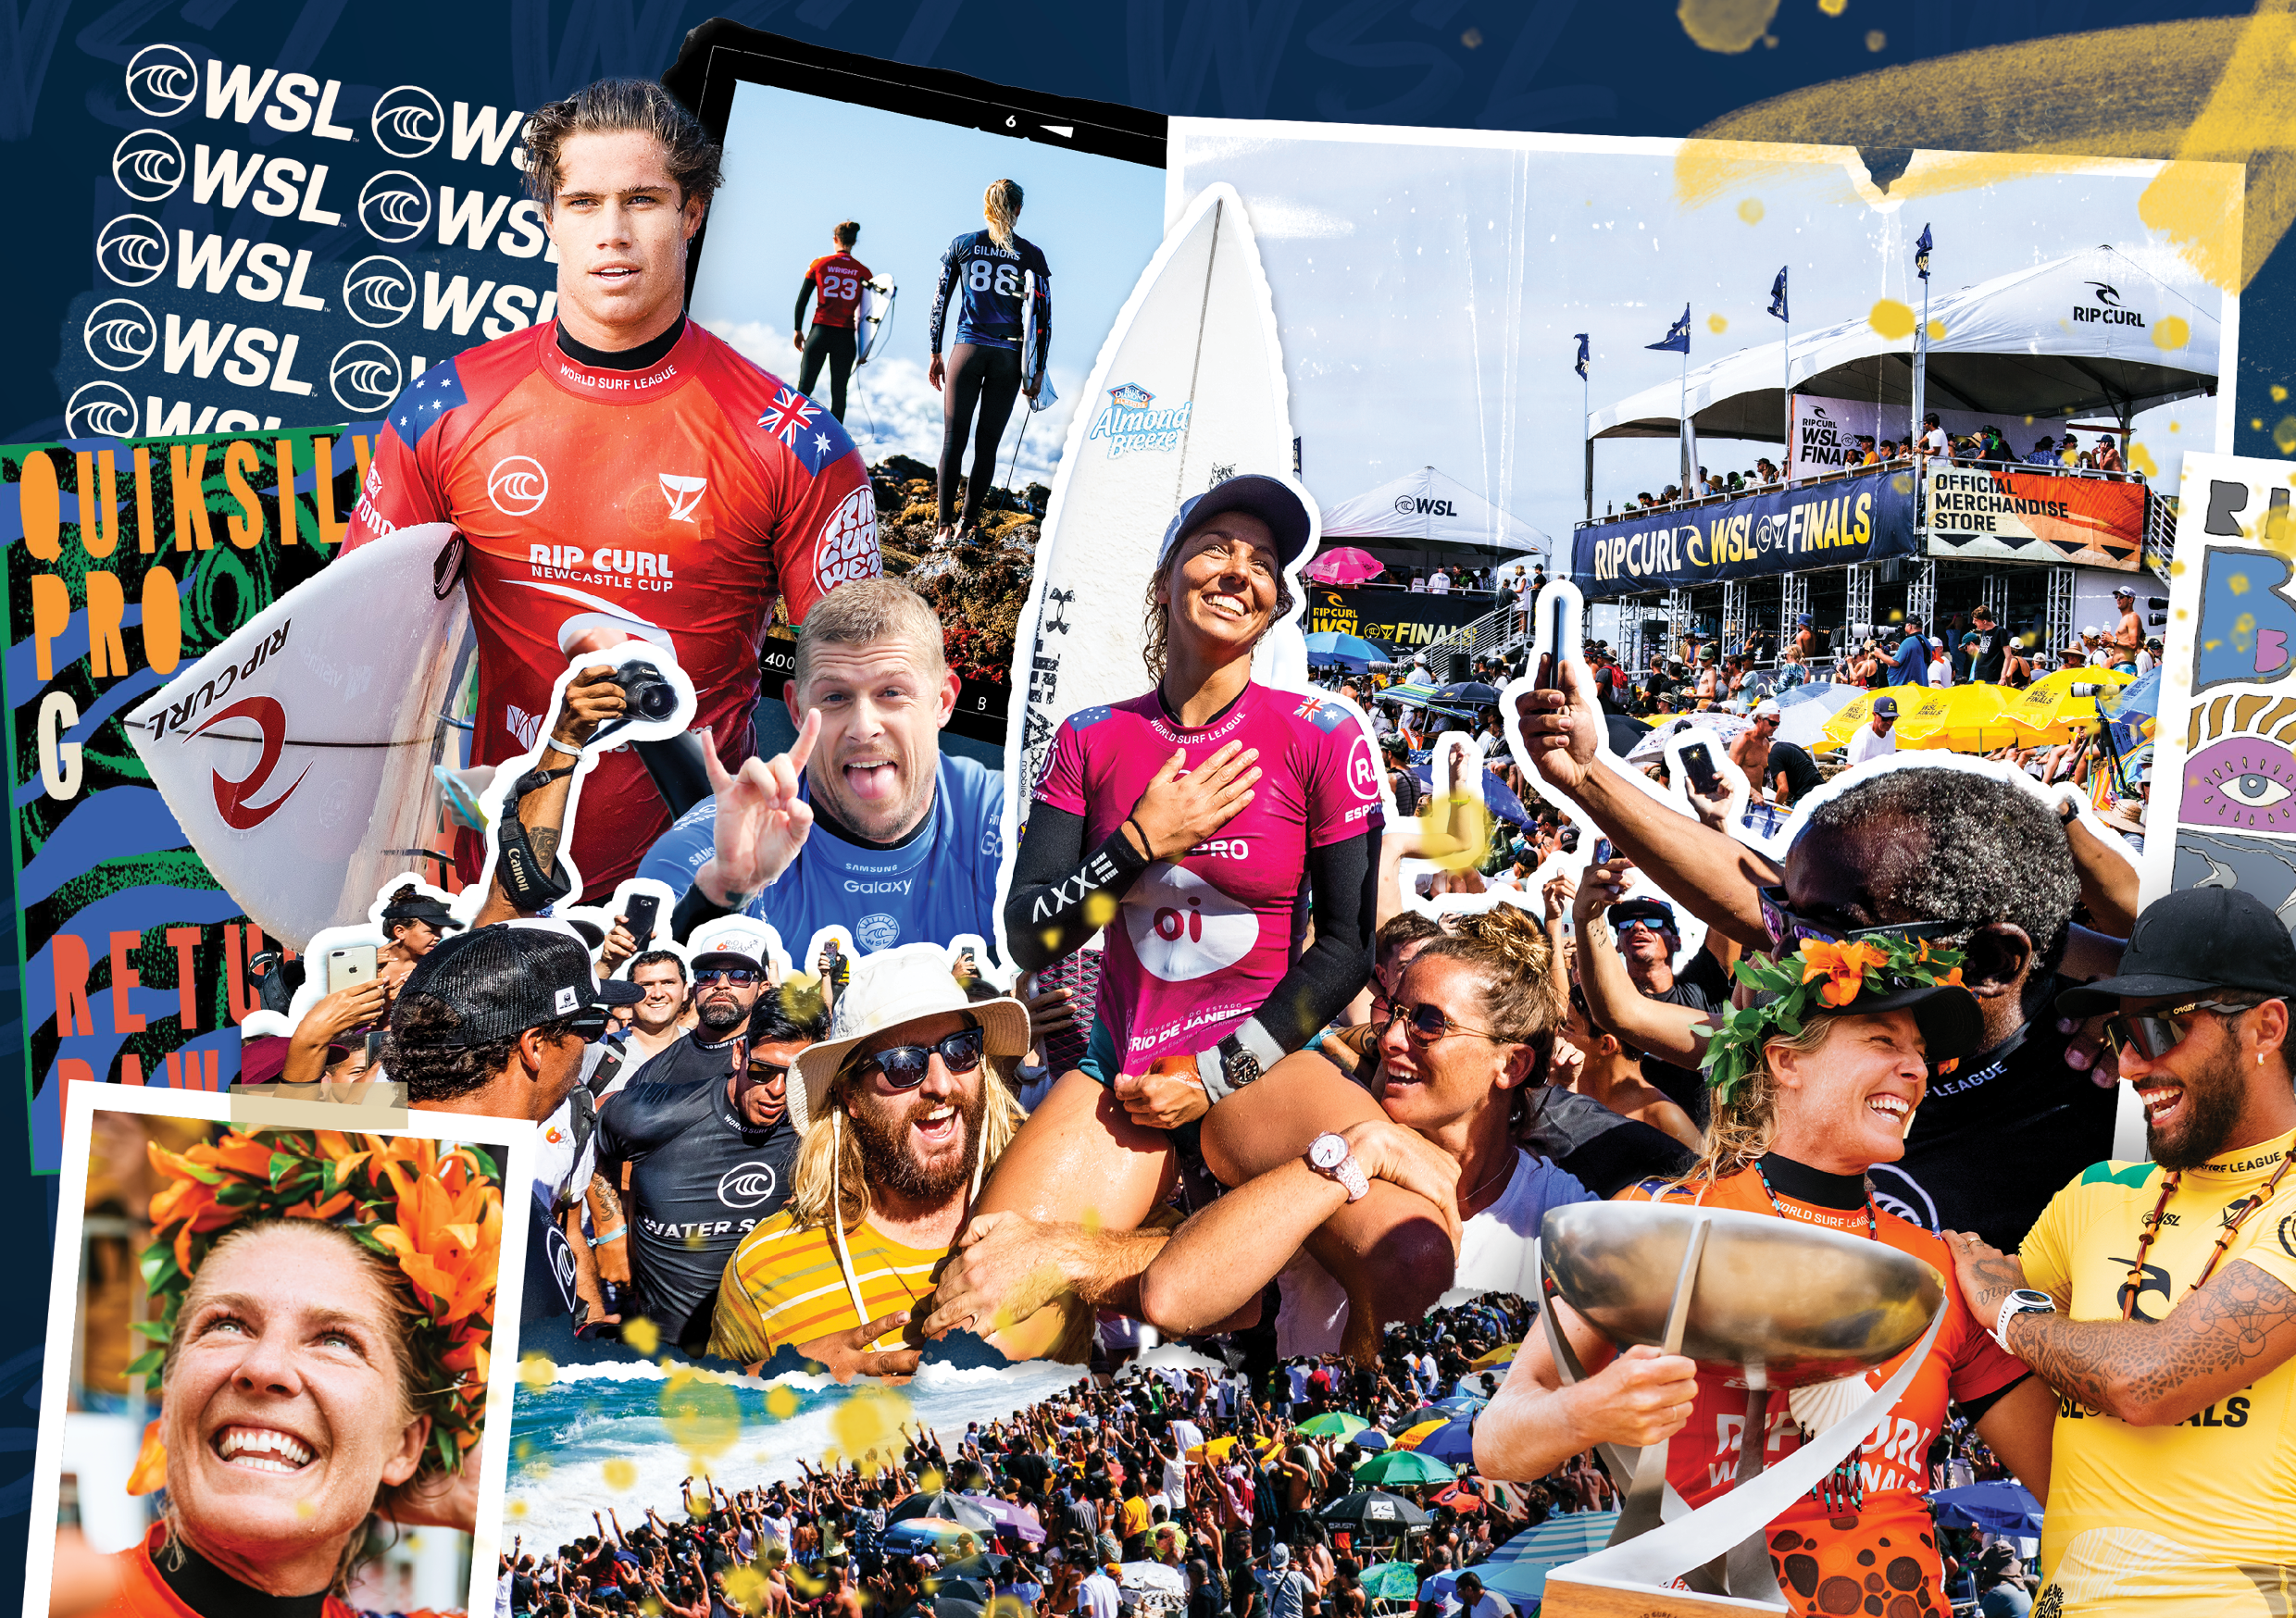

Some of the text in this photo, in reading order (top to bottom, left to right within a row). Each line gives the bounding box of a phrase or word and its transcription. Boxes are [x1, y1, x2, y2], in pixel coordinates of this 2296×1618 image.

[1005, 115, 1017, 128] 6
[827, 265, 859, 276] WRIGHT
[823, 275, 858, 301] 23
[2073, 305, 2146, 329] RIP CURL
[560, 363, 678, 391] WORLD SURF LEAGUE
[1115, 391, 1148, 402] DIAMOND
[1091, 401, 1192, 441] Almond
[1108, 430, 1178, 460] Breeze
[1803, 427, 1842, 447] WSL
[1935, 473, 2018, 495] OFFICIAL
[1416, 497, 1459, 517] WSL
[1935, 492, 2069, 518] MERCHANDISE
[1935, 512, 1997, 532] STORE
[1595, 492, 1872, 581] RIP CURL WSL FINALS
[529, 543, 674, 579] RIP CURL
[531, 565, 674, 592] NEWCASTLE CUP
[31, 566, 181, 680] PRO
[1313, 607, 1358, 618] RIP CURL
[241, 617, 293, 680] RIP
[148, 665, 238, 741] CURL
[2025, 695, 2053, 705] FINALS
[2031, 690, 2049, 699] WSL
[1151, 711, 1246, 744] WORLD SURF LEAGUE
[37, 691, 83, 801] G
[508, 848, 530, 892] Canon
[845, 863, 898, 873] SAMSUNG
[844, 878, 913, 896] Galaxy
[865, 938, 890, 947] WSL
[1189, 1009, 1202, 1018] DO
[1205, 1002, 1242, 1014] ESTADO
[1158, 1023, 1181, 1044] DE
[1159, 1045, 1167, 1054] de
[1933, 1060, 2008, 1098] LEAGUE
[724, 1114, 748, 1133] WORLD
[2229, 1151, 2282, 1174] LEAGUE
[1772, 1199, 1813, 1221] WORLD
[1815, 1212, 1845, 1227] SURF
[644, 1215, 732, 1238] WATER
